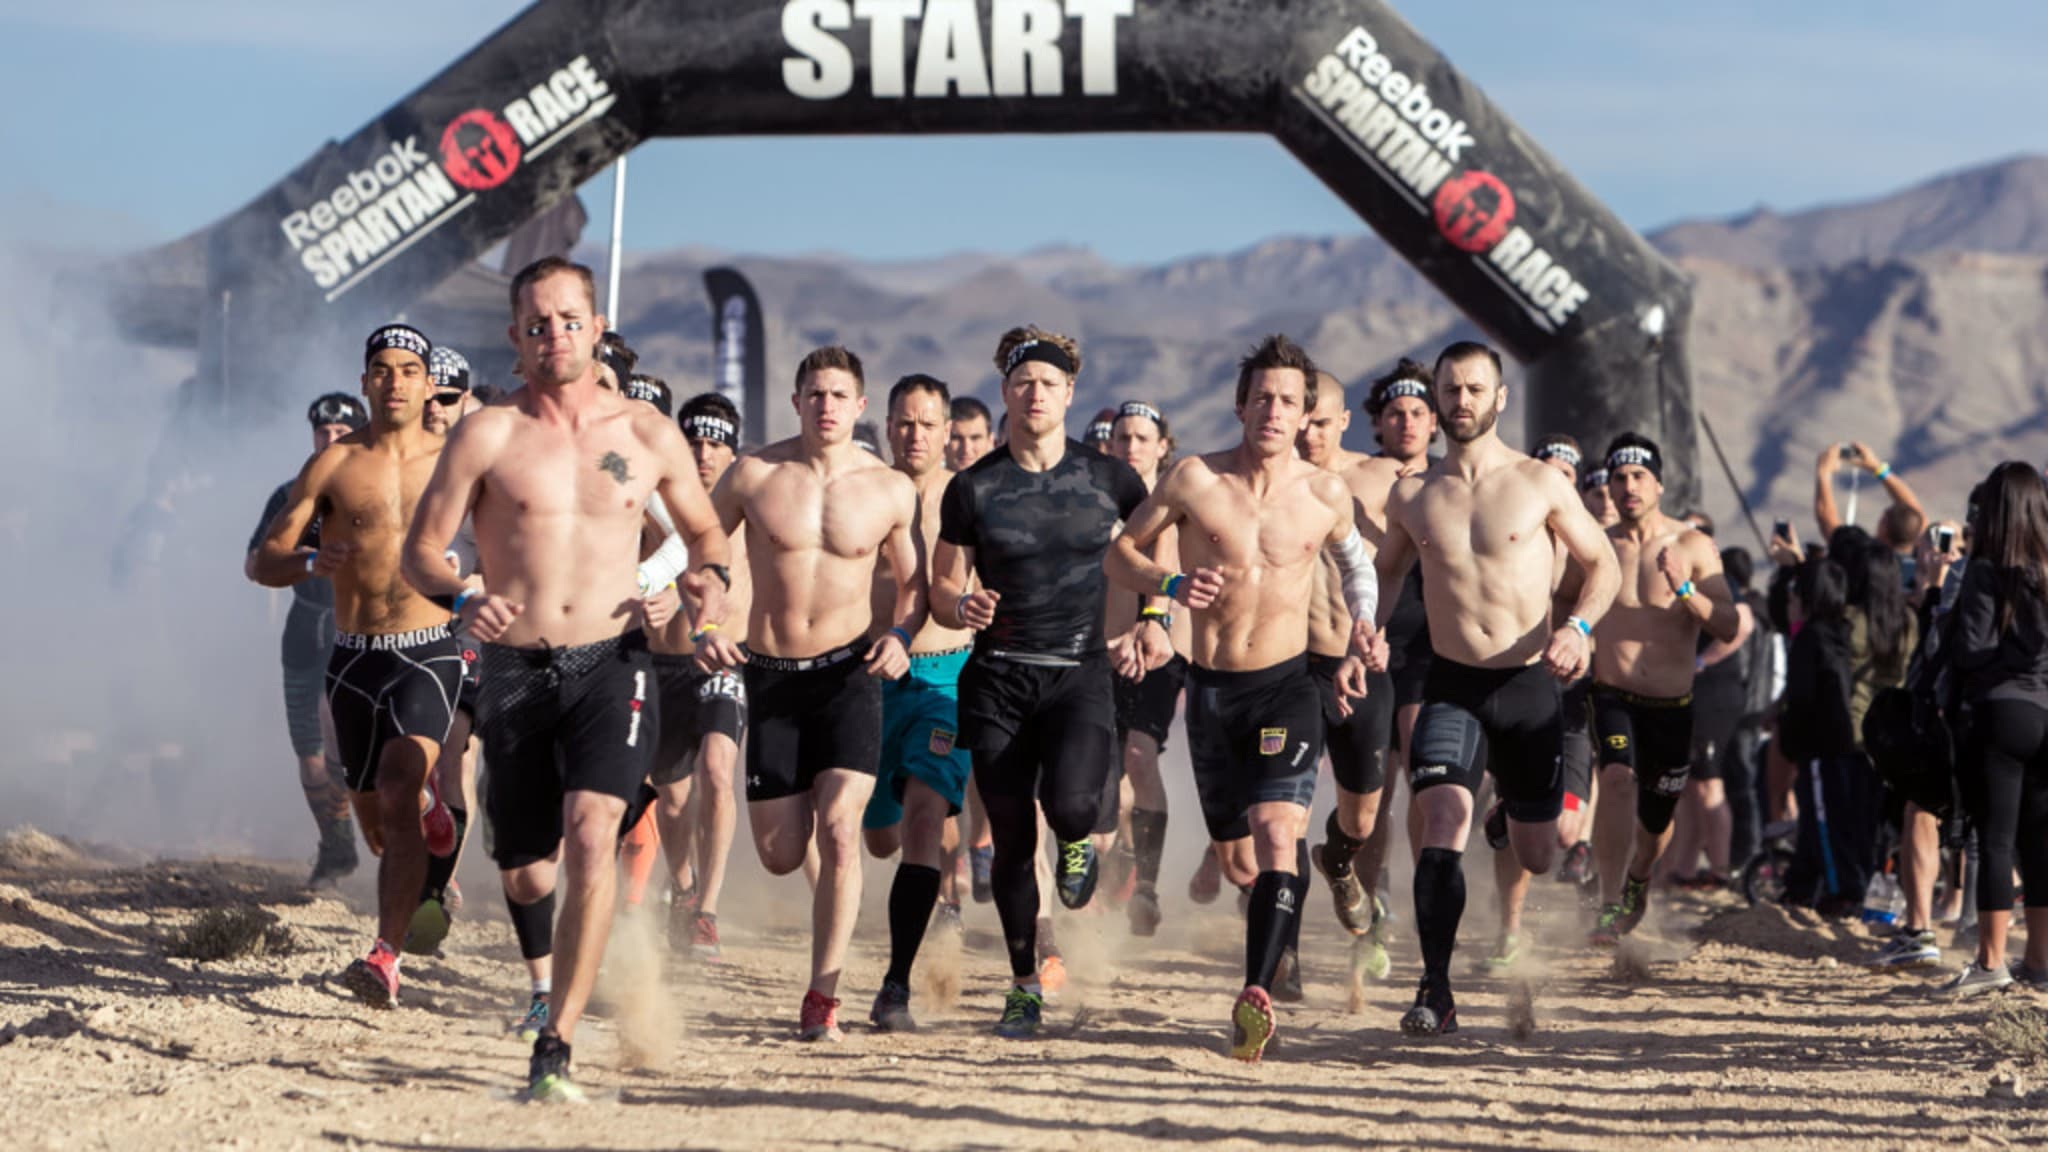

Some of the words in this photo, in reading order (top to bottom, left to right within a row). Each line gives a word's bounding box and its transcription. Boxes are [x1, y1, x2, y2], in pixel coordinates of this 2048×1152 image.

[782, 0, 1134, 99] START
[1335, 26, 1475, 161] Reebok
[281, 135, 429, 249] Reebok
[302, 161, 458, 288] SPARTAN
[504, 54, 609, 146] RACE
[1304, 53, 1453, 198] SPARTAN
[1489, 226, 1590, 326] RACE
[336, 632, 366, 649] DER
